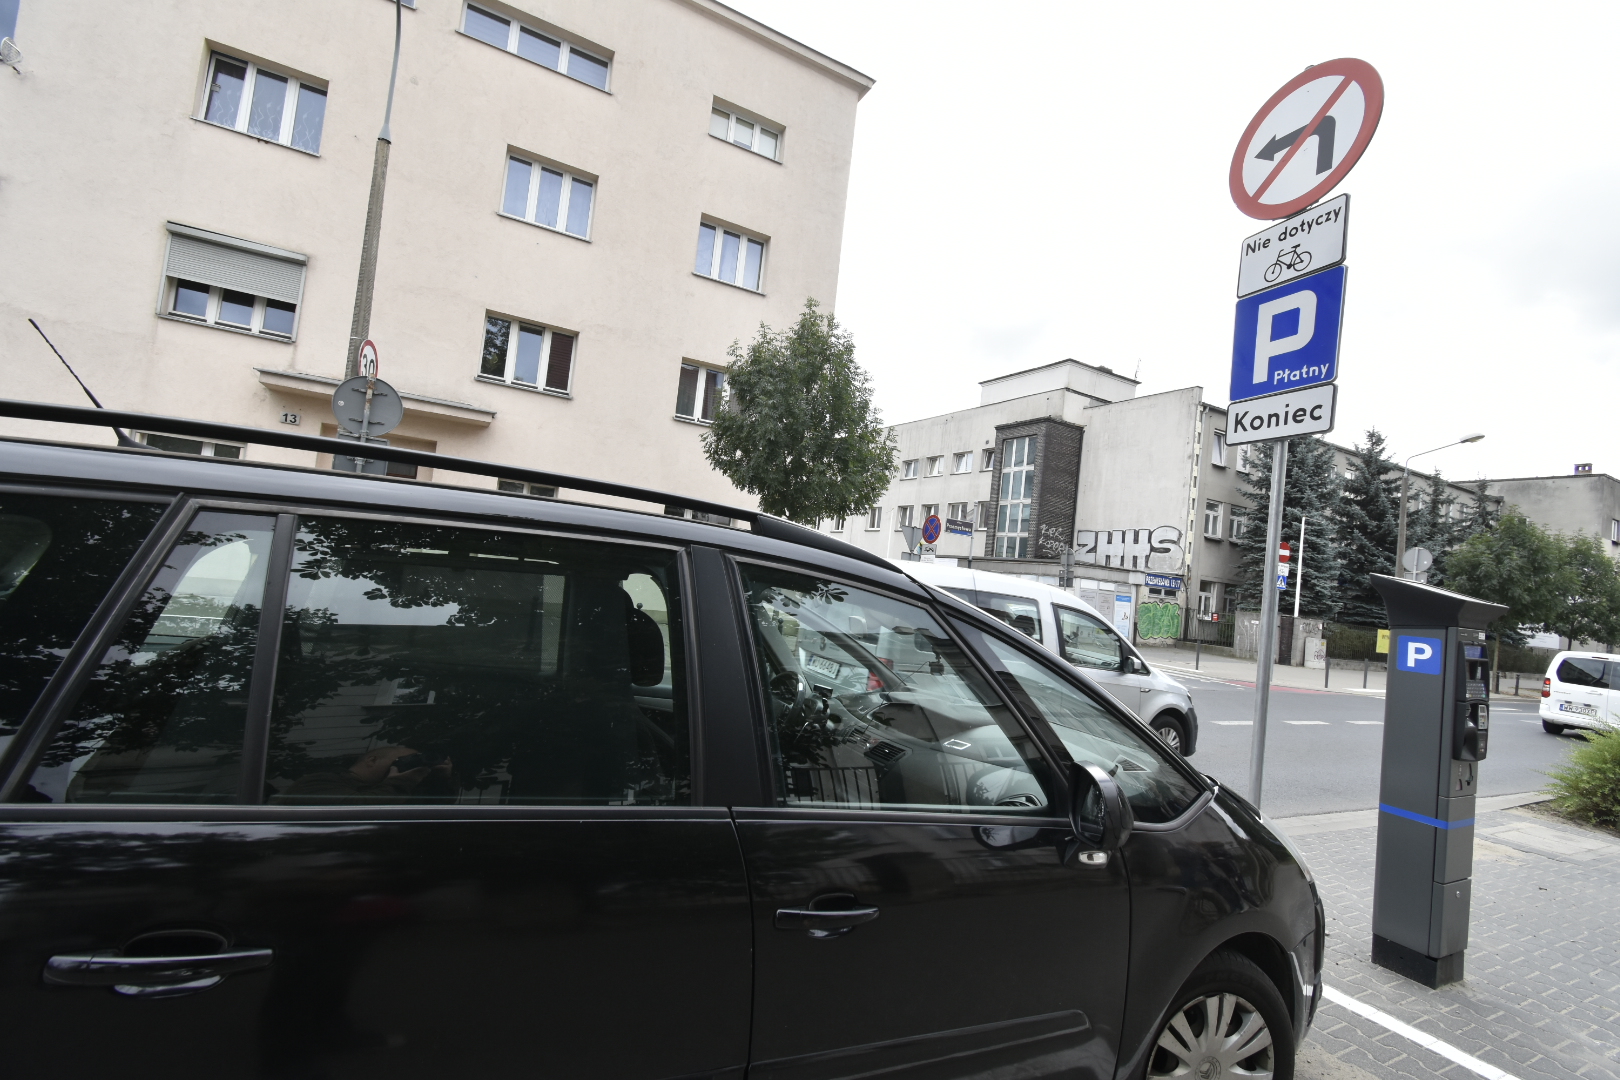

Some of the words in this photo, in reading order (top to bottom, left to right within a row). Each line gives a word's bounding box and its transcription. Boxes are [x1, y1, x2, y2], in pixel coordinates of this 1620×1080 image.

[1245, 238, 1271, 256] Nie
[1277, 206, 1342, 241] dotyczy
[1252, 289, 1318, 385] P
[362, 354, 375, 377] 30
[1273, 362, 1330, 385] Płatny
[282, 413, 297, 424] 13
[1233, 403, 1323, 433] Koniec
[1407, 641, 1433, 667] P
